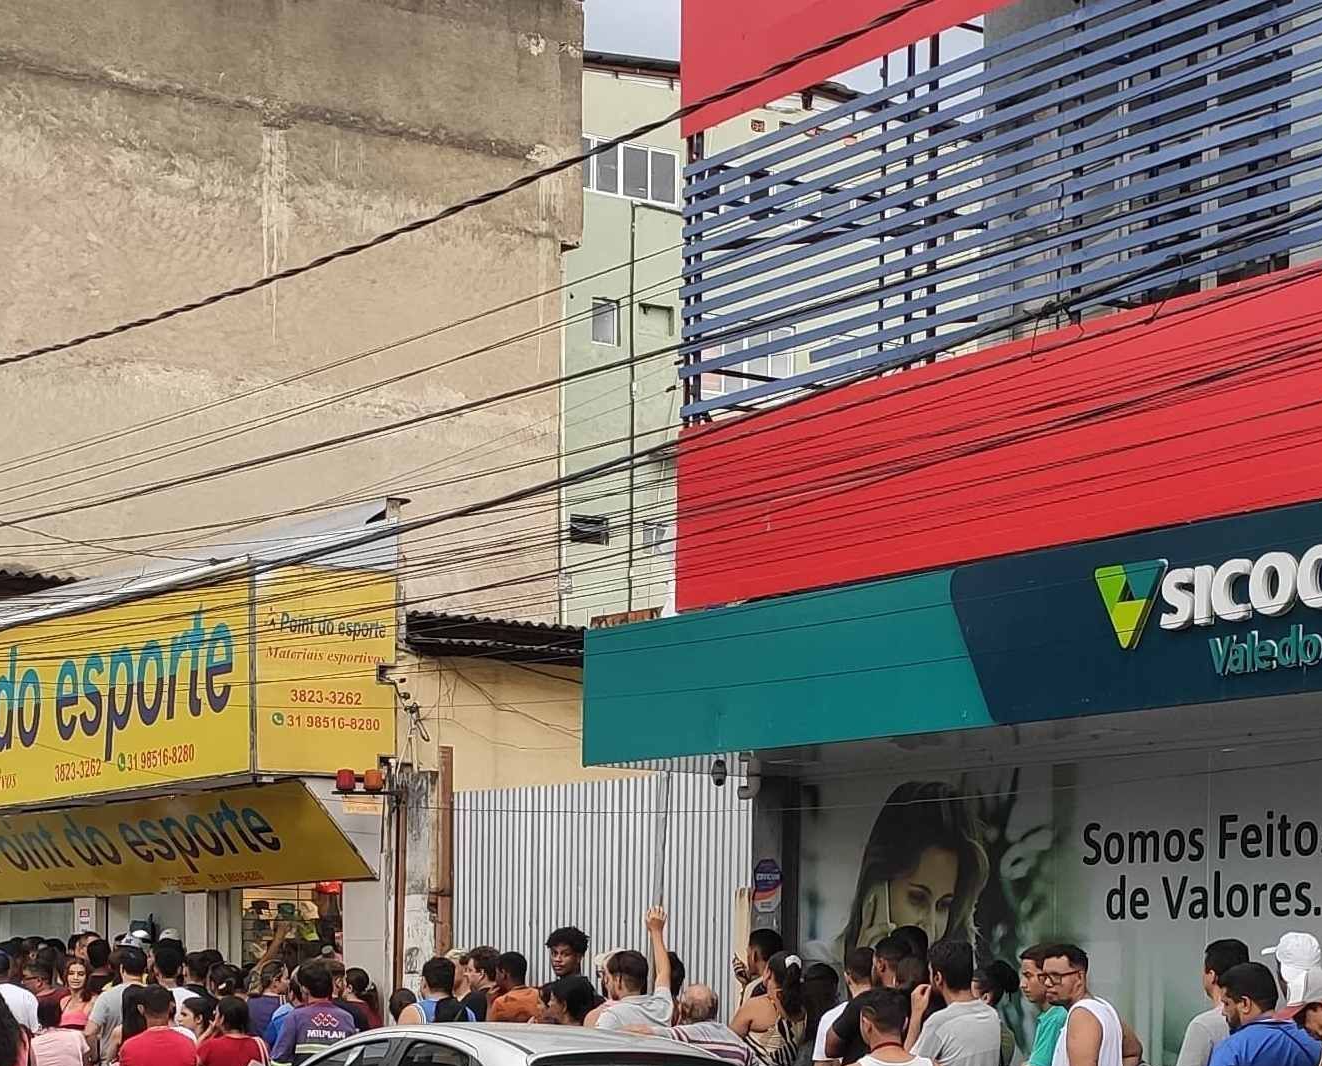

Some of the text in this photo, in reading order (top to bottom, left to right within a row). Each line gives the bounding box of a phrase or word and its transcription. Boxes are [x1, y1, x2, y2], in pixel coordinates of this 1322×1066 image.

[279, 612, 315, 635] Point
[338, 619, 386, 642] esporte
[266, 646, 324, 661] Materiais
[1209, 630, 1278, 676] Vale
[56, 602, 234, 762] esporte
[290, 689, 363, 706] 3823-3262
[287, 714, 381, 731] 31 98516-8280
[55, 758, 102, 783] 3823-3262
[127, 743, 195, 771] 31 98516-8280
[64, 814, 123, 867] do
[119, 800, 282, 874] esporte
[1082, 821, 1206, 866] Somos
[1105, 871, 1322, 922] de Valores.
[306, 1029, 346, 1039] MILPLAN
